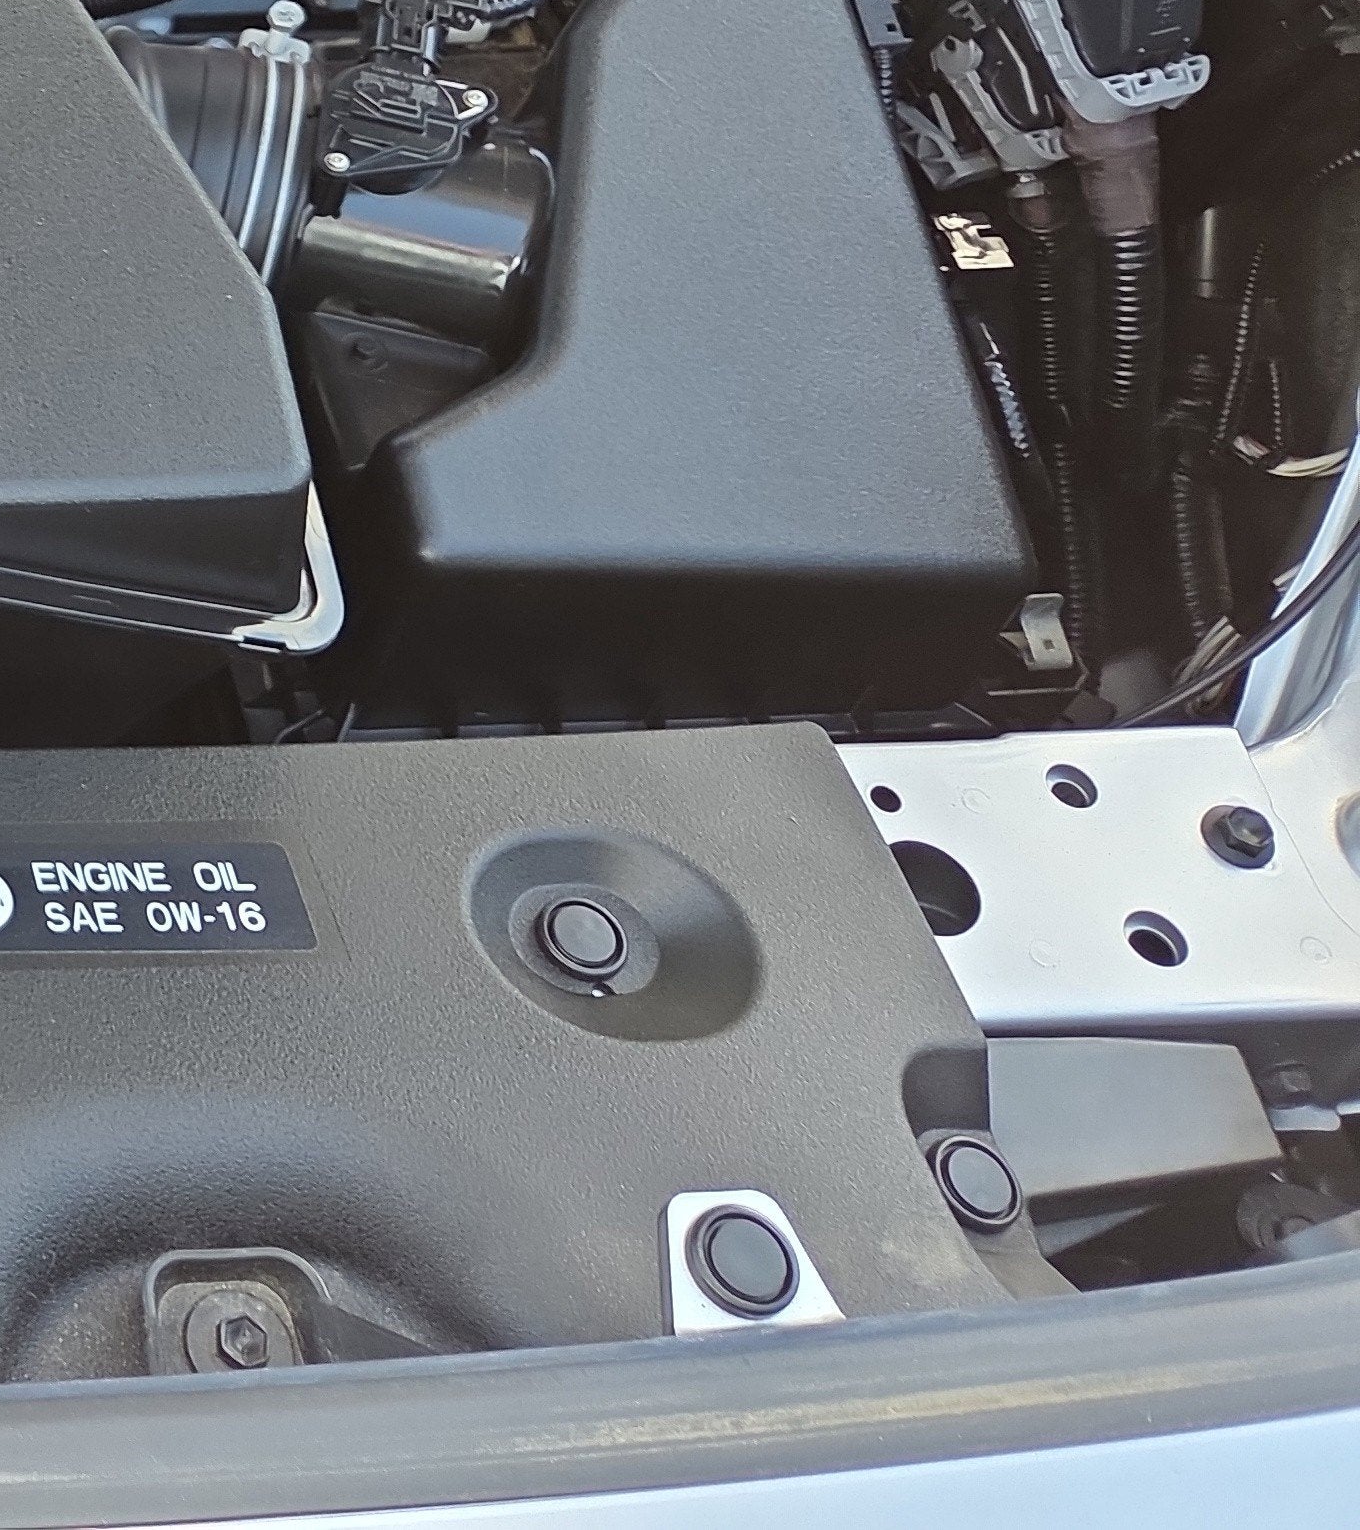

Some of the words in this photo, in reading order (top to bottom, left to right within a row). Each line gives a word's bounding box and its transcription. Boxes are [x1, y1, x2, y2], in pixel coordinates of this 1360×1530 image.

[31, 861, 172, 894] ENGINE
[193, 861, 257, 894] OIL
[43, 901, 124, 933] SAE
[146, 901, 267, 933] 0W-16
